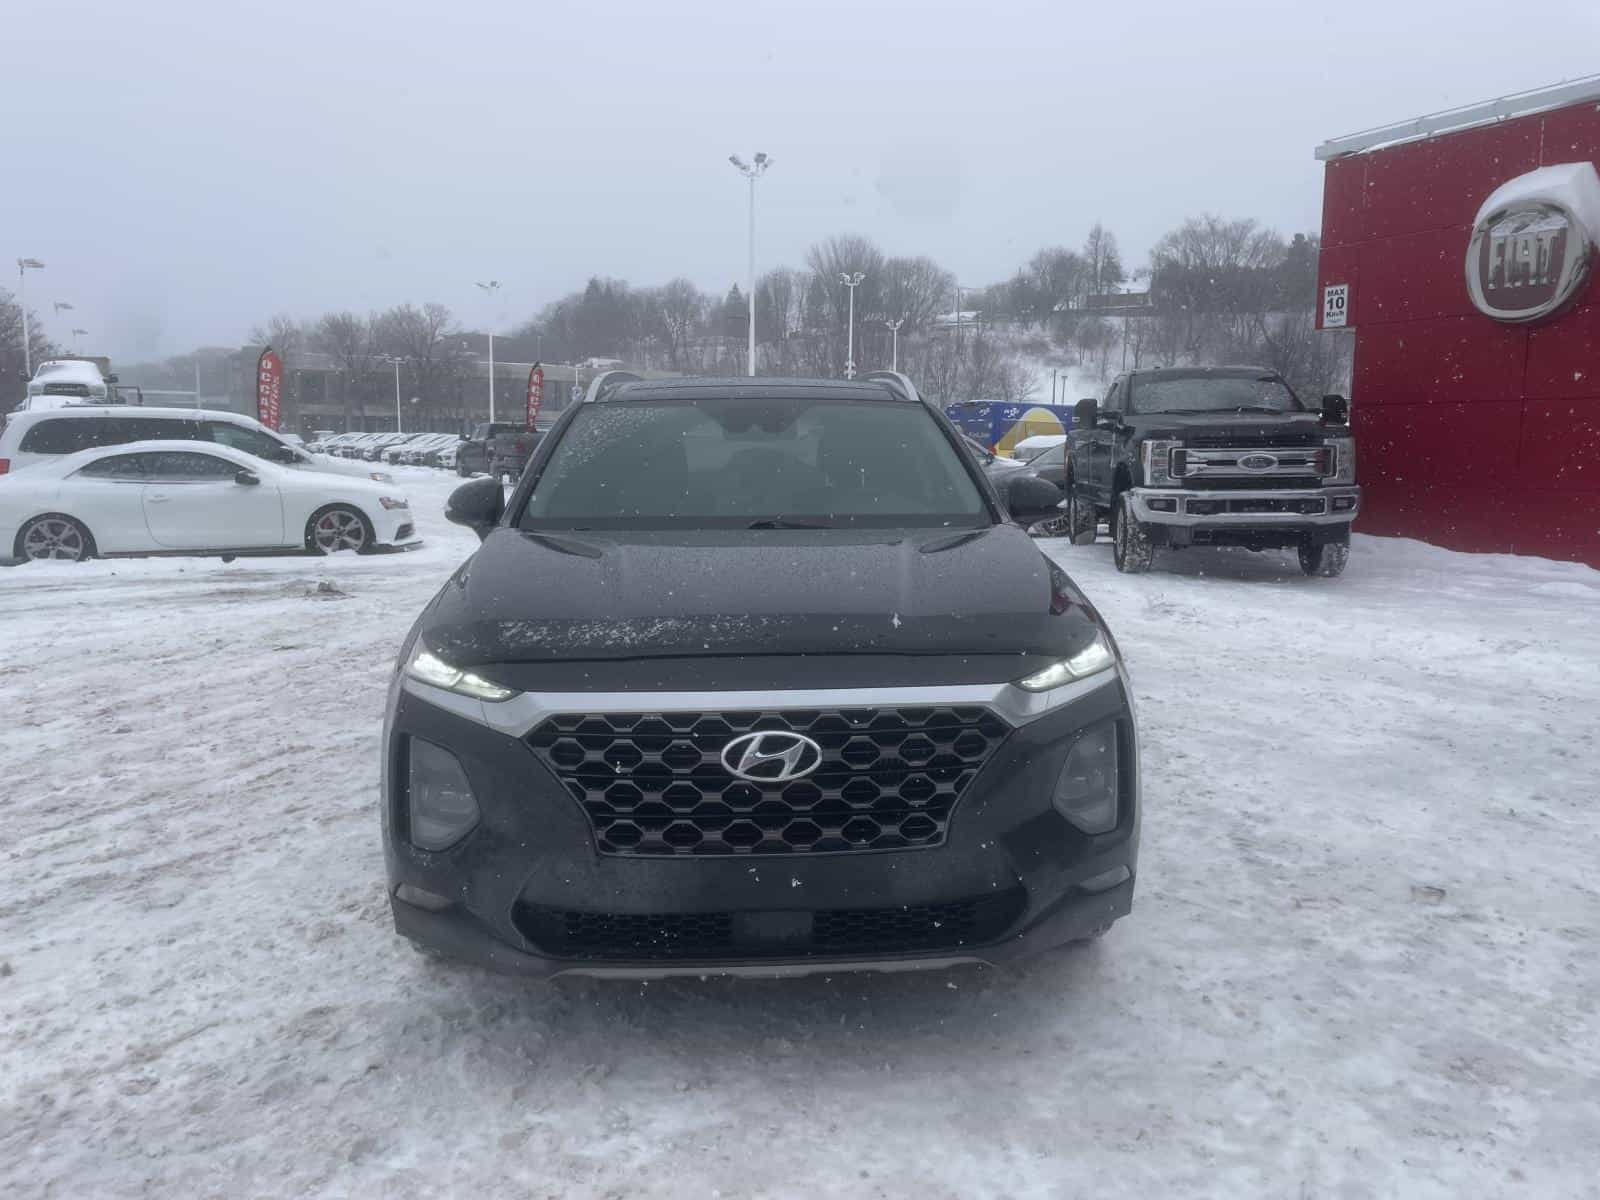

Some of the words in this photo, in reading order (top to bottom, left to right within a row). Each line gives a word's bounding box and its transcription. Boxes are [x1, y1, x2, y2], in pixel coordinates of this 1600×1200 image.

[1488, 227, 1564, 290] FIAT
[1327, 287, 1345, 297] MAX
[1326, 296, 1345, 310] 10
